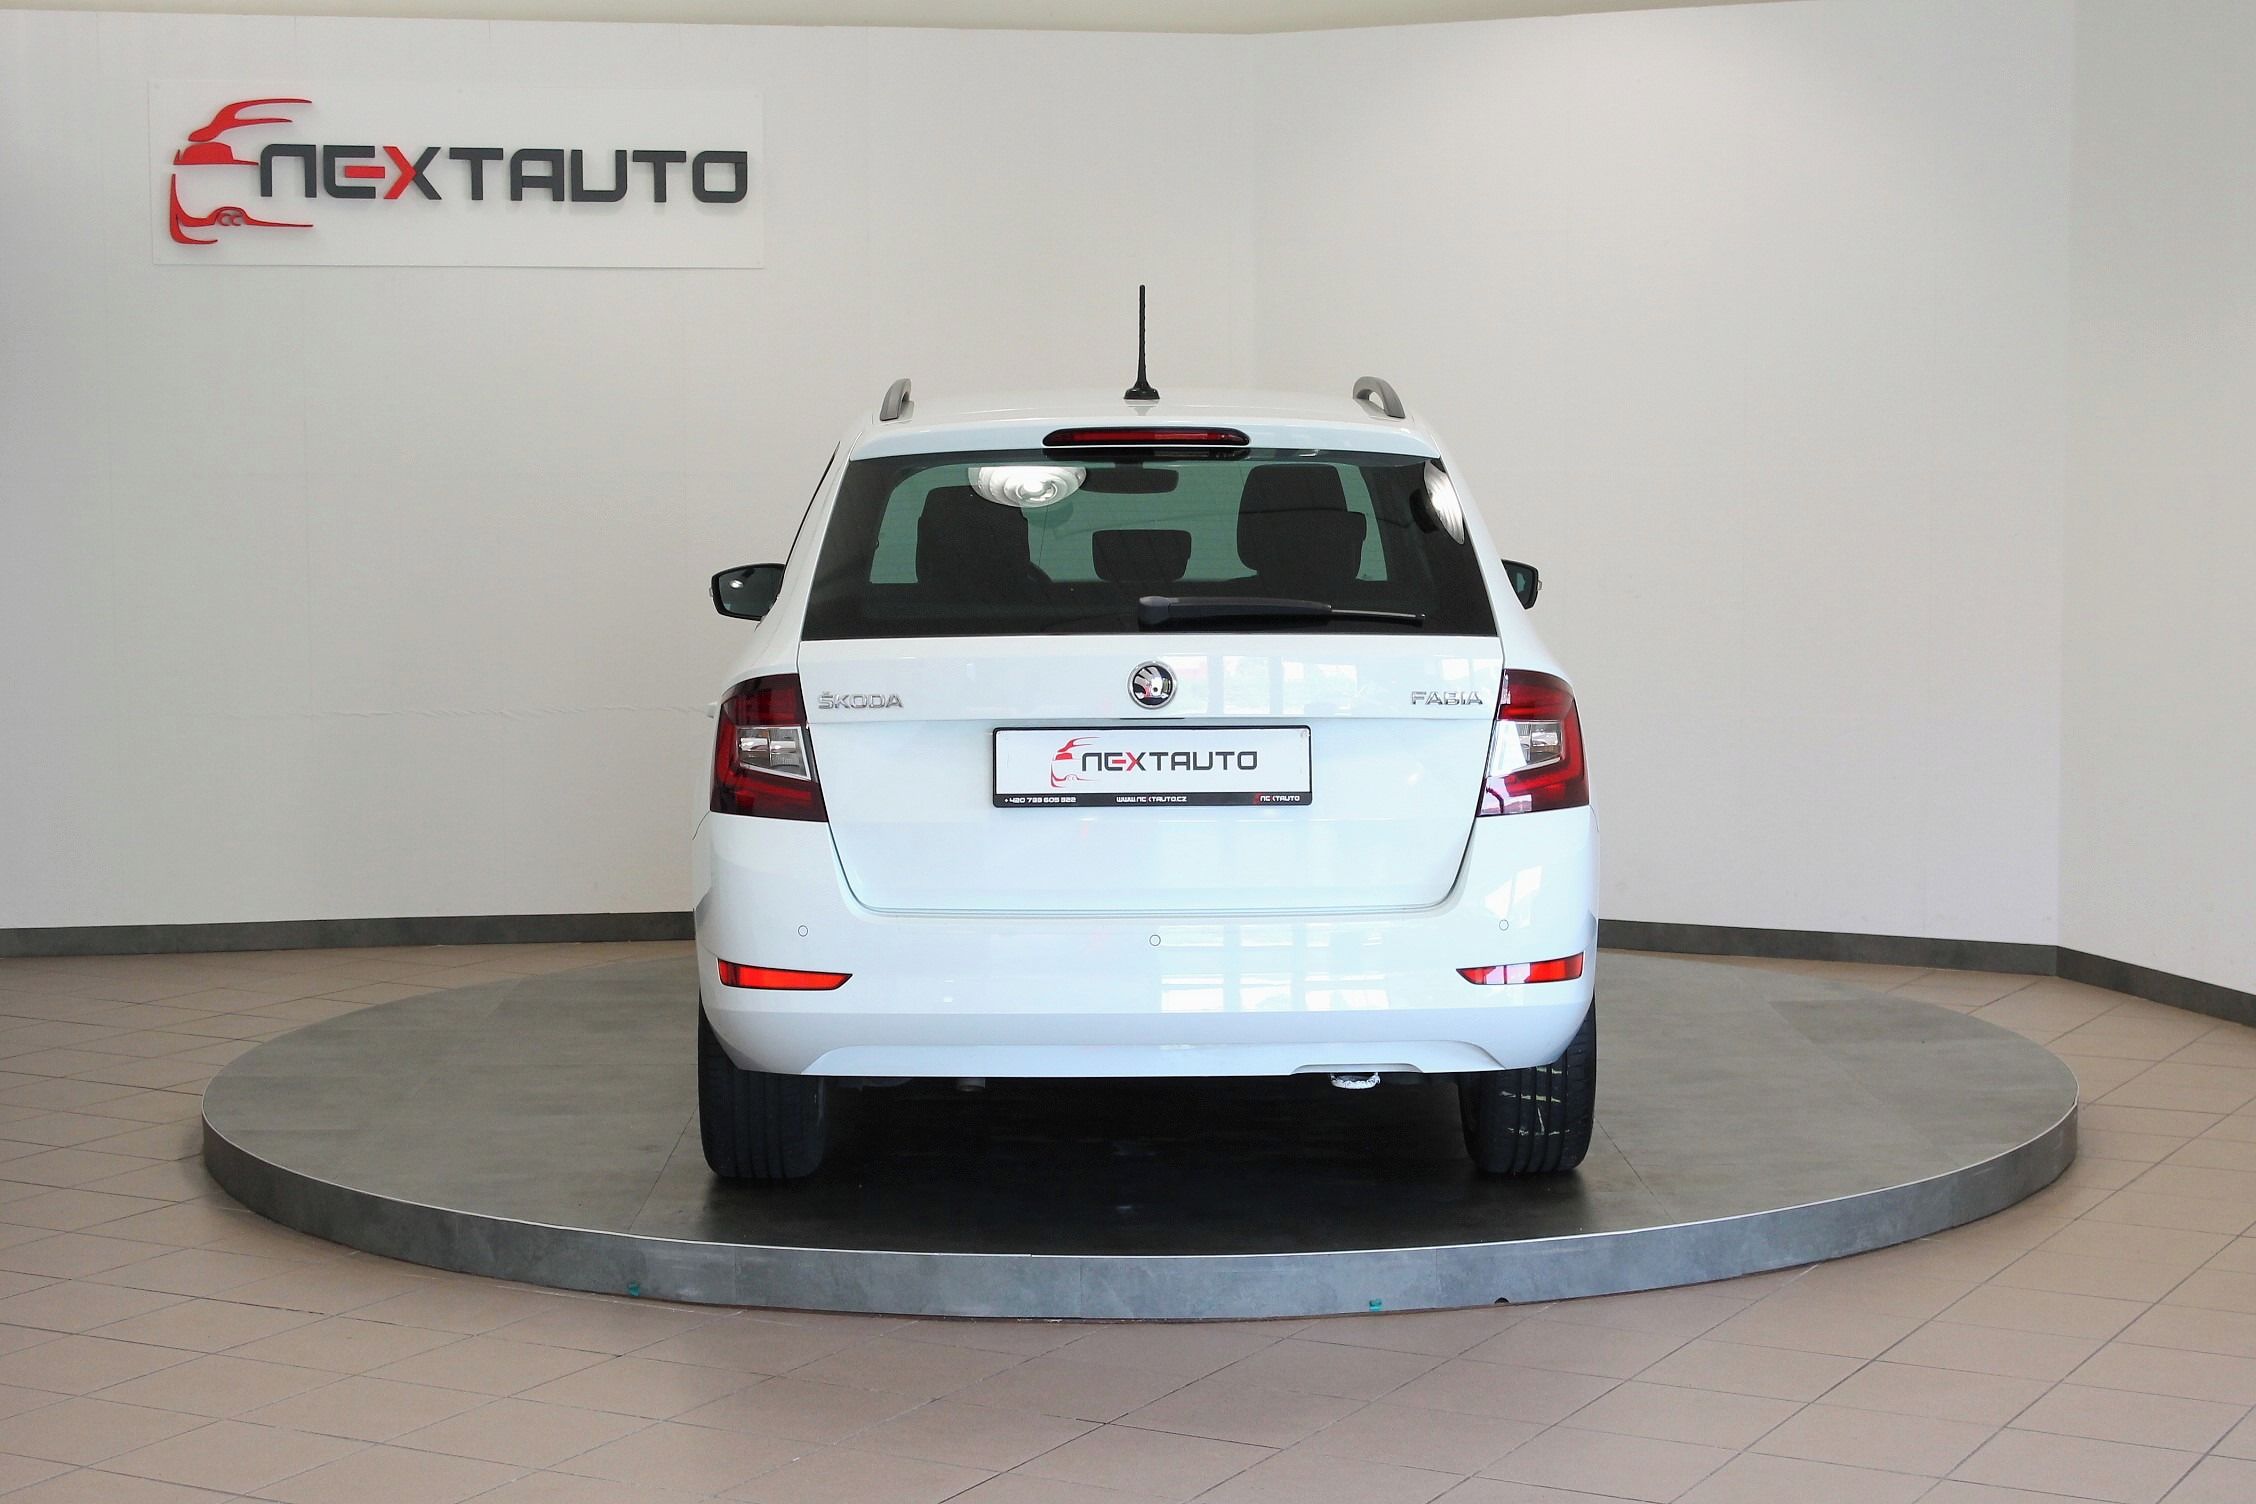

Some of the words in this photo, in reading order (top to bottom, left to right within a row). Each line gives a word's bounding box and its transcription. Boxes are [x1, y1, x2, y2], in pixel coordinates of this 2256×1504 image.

[260, 144, 748, 204] NEXTAUTO
[817, 691, 903, 709] ŠKODA
[1410, 691, 1483, 705] FABIA
[1081, 750, 1258, 772] NEXTAUTO
